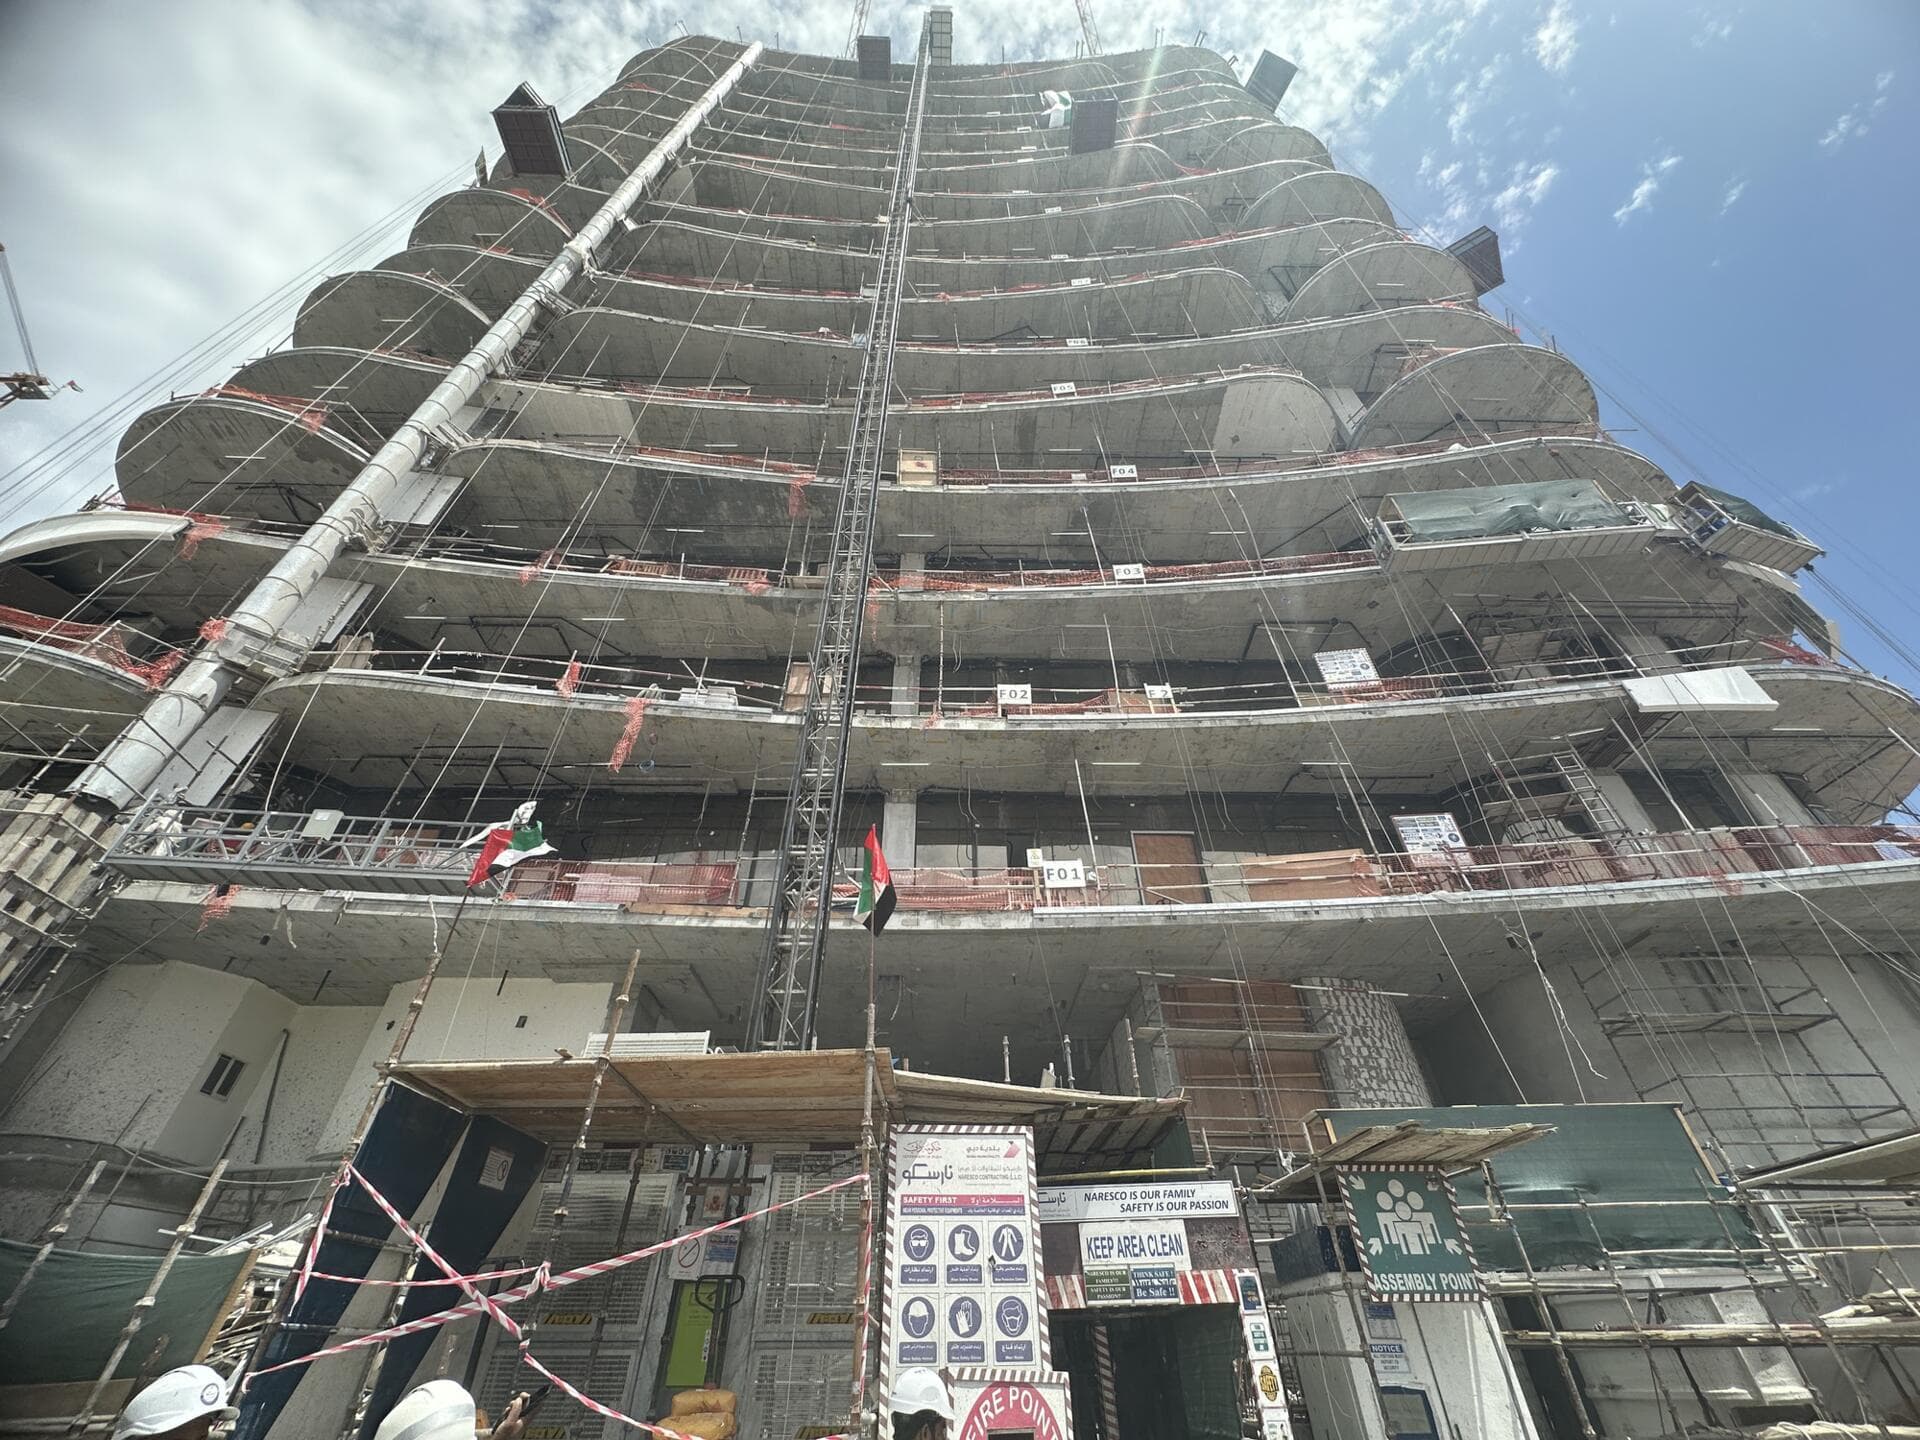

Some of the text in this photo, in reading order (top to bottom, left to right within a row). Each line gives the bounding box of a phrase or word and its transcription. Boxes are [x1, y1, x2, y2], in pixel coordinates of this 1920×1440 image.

[1116, 567, 1141, 575] F03
[999, 689, 1028, 699] F02
[1046, 868, 1081, 880] F01
[903, 1196, 934, 1204] SAFETY
[1084, 1189, 1196, 1201] NARESCO IS OUR FAMILY
[1120, 1200, 1229, 1213] SAFETY IS OUR PASSION
[1086, 1233, 1184, 1260] KEEP AREA CLEAN
[1373, 1272, 1479, 1291] ASSEMBLY POINT
[1136, 1288, 1147, 1297] Be
[1149, 1288, 1167, 1297] Safe
[1372, 1345, 1401, 1353] NOTICE
